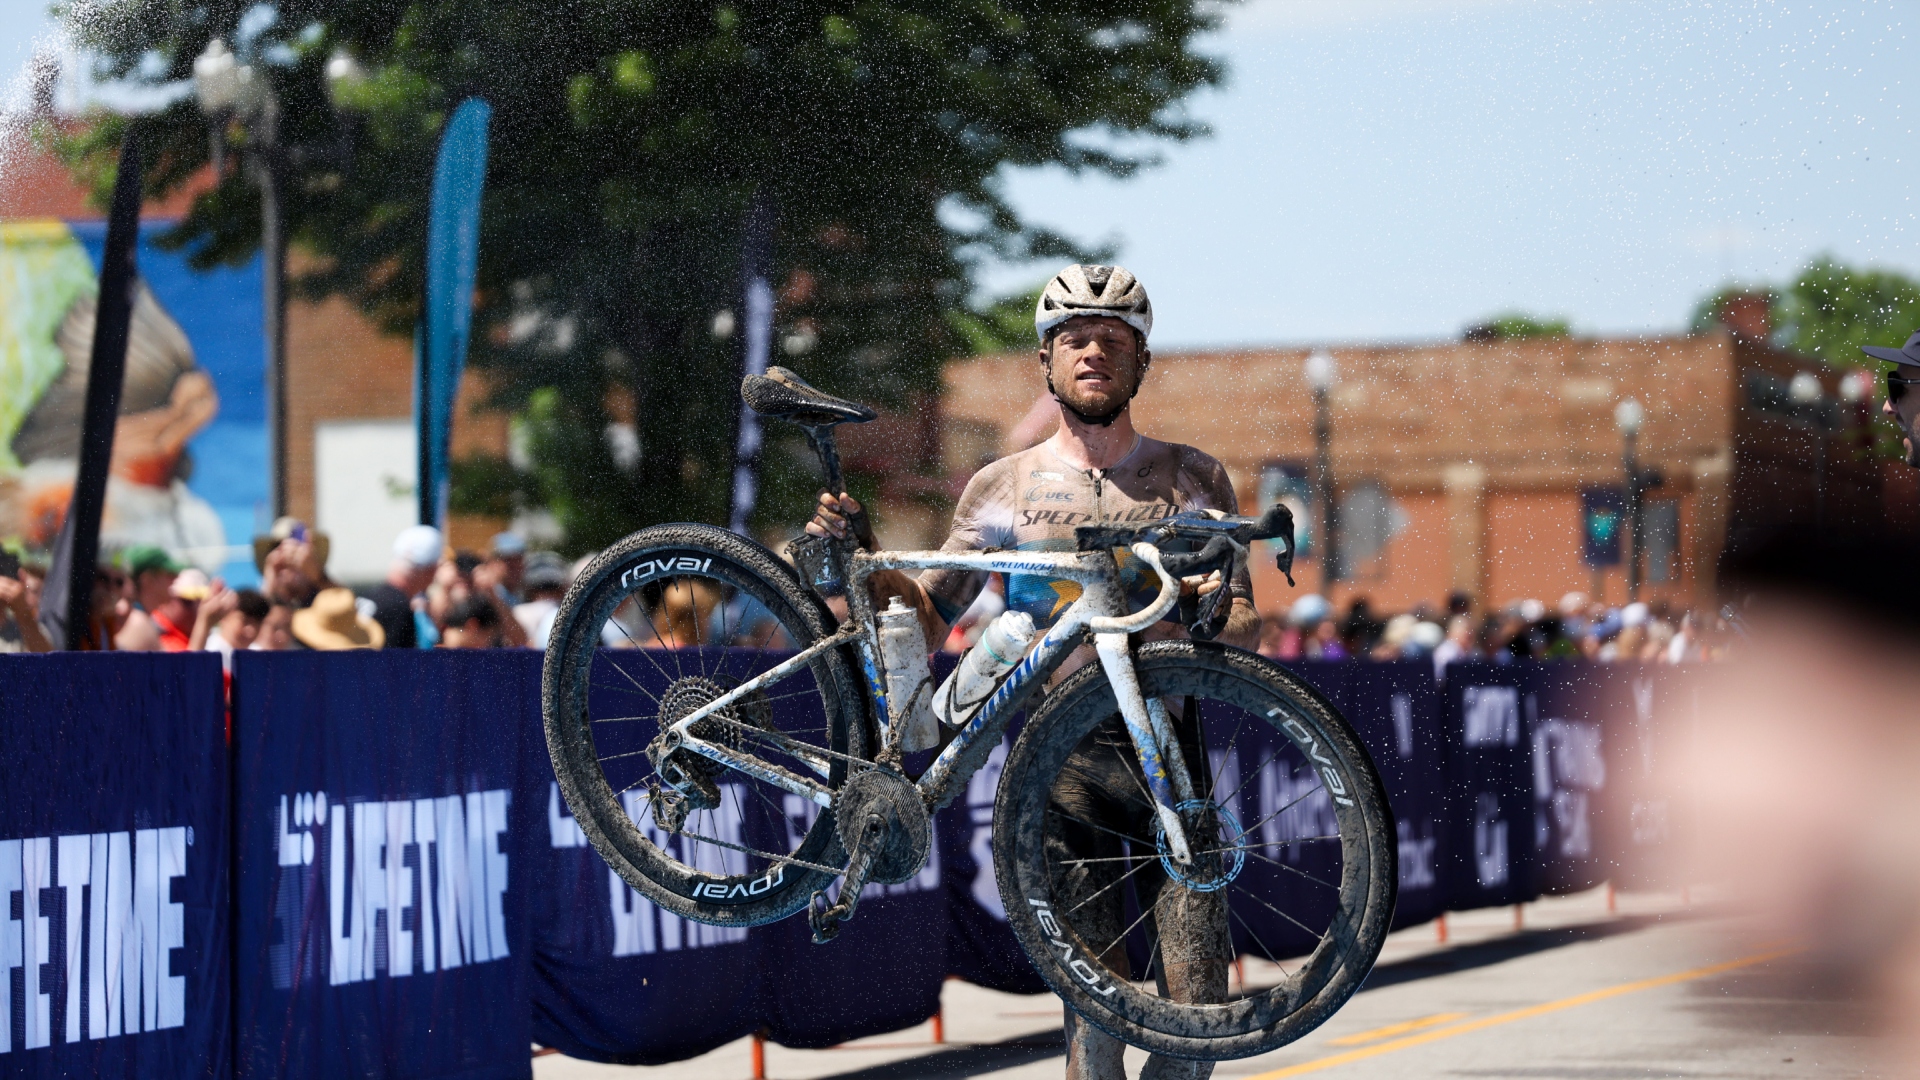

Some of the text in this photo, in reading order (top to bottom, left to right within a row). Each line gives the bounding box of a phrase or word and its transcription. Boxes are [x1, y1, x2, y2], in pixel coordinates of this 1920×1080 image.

[1045, 492, 1075, 501] UEC
[621, 556, 713, 589] roval
[1266, 707, 1354, 807] roval
[692, 866, 784, 899] roval
[1028, 898, 1117, 996] roval
